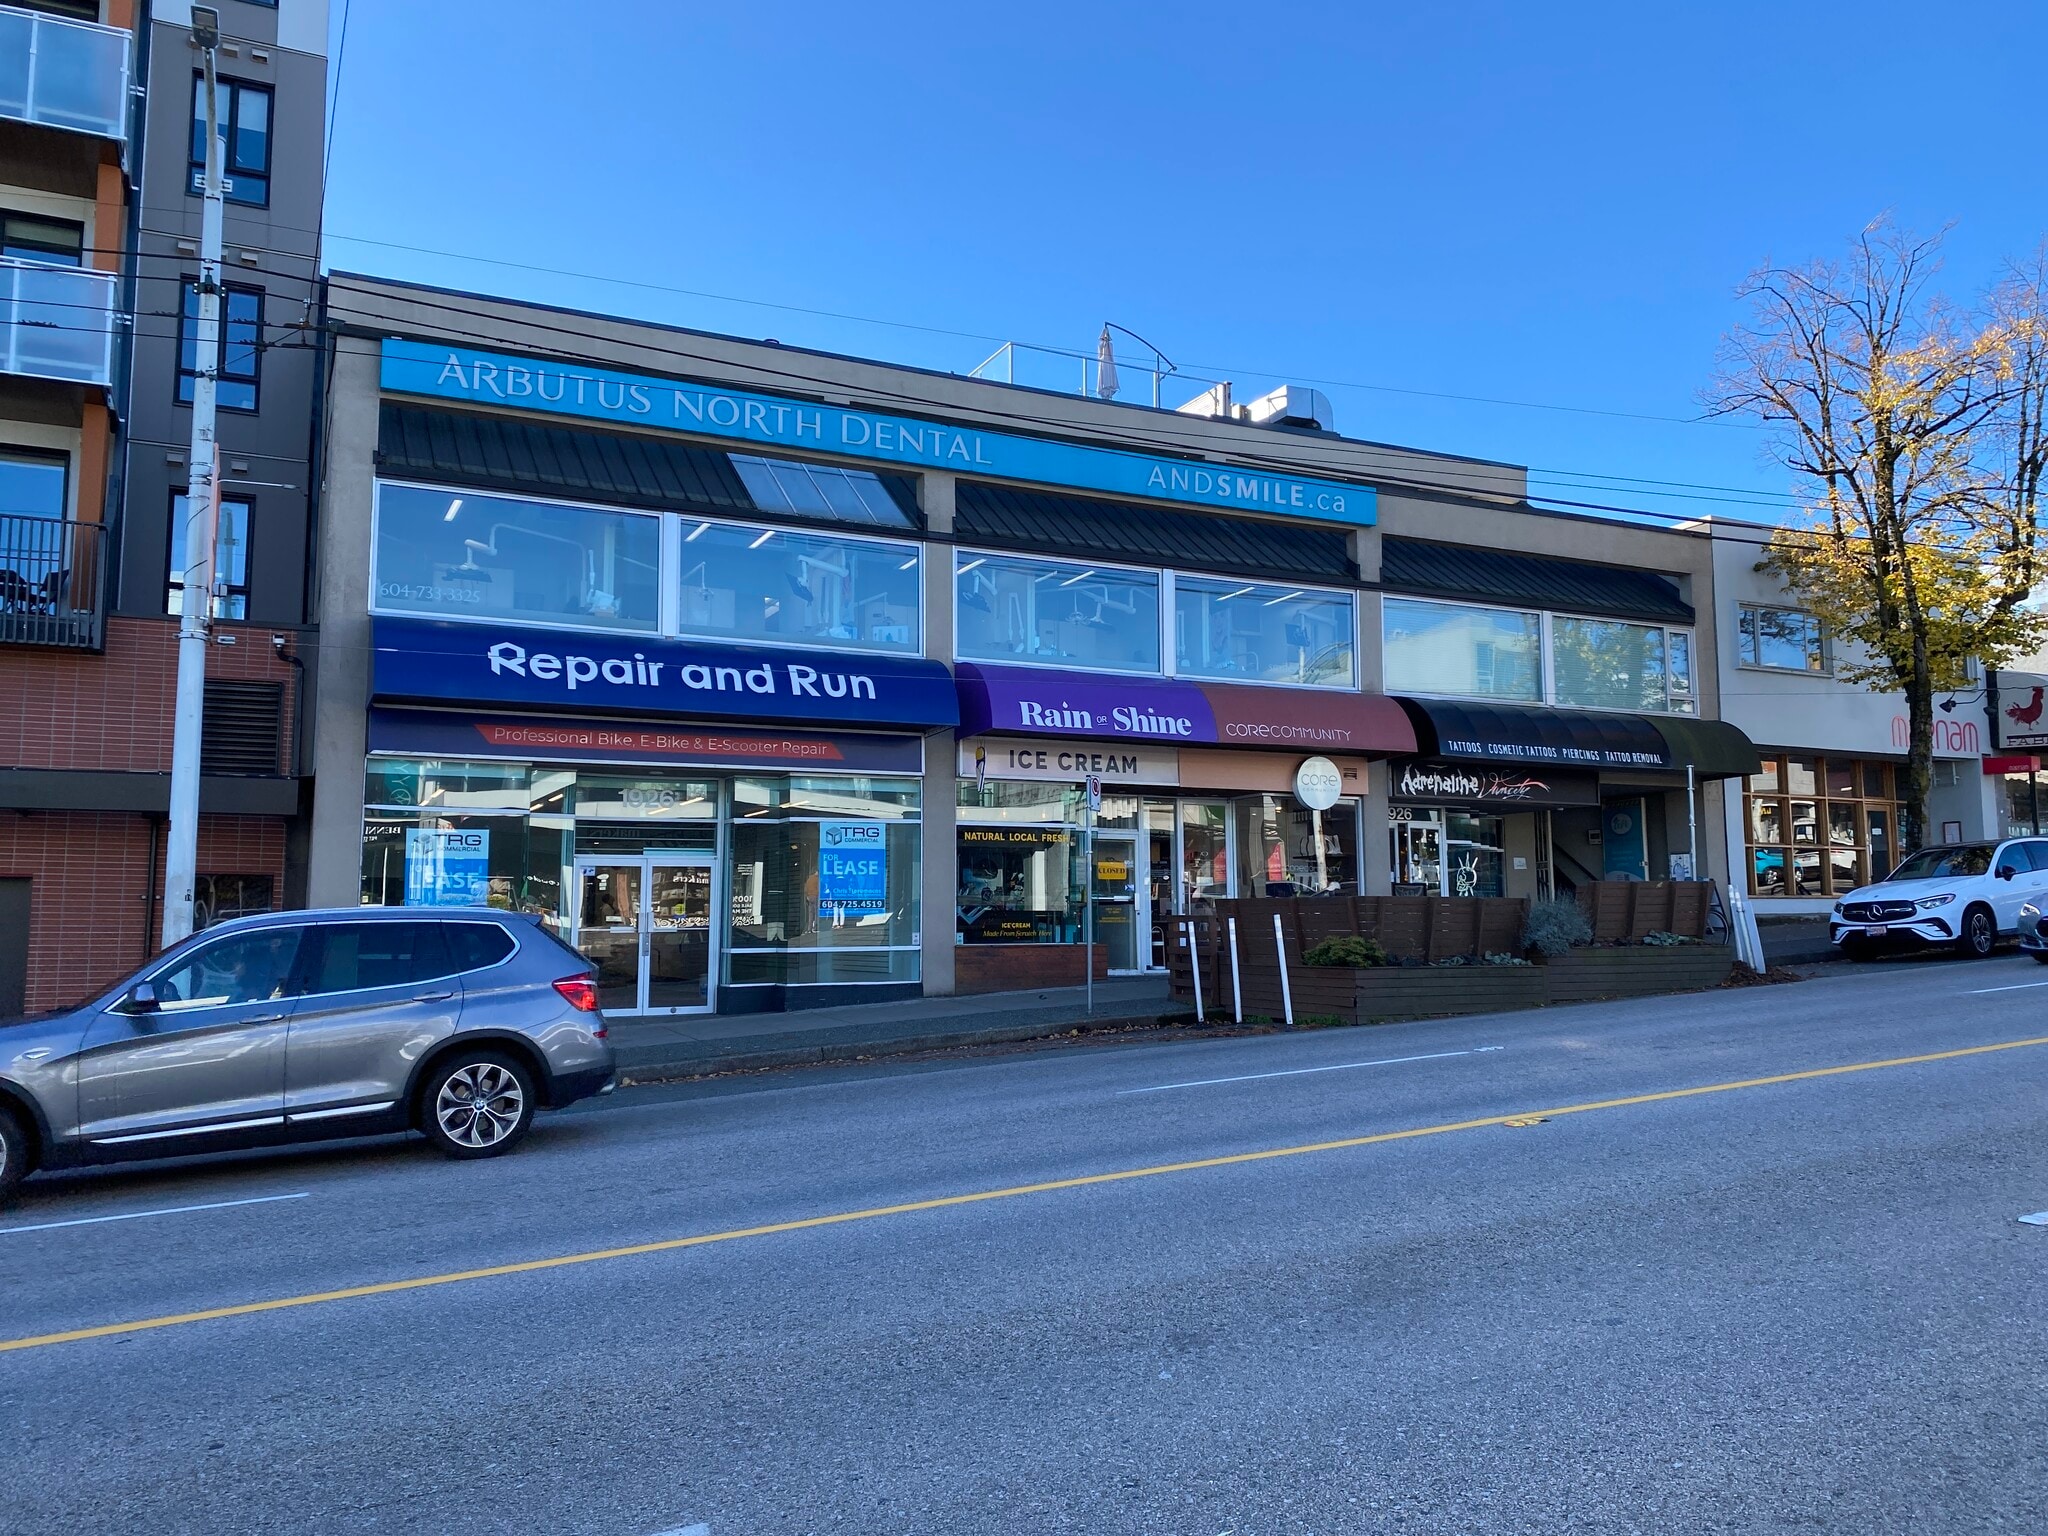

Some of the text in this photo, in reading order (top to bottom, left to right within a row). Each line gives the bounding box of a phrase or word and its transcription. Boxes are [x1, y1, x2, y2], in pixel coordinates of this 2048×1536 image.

[437, 353, 993, 465] ARBUTUS NORTH DENTAL
[1148, 465, 1345, 513] ANDSMILE.ca
[381, 583, 480, 603] 604-733-3325
[488, 641, 876, 700] Repair and Run
[1019, 700, 1192, 736] Rain OR Shine
[494, 726, 827, 757] Professional Bike, E-Bike & E-Scooter Repair
[1891, 716, 1979, 752] mnam
[2007, 736, 2048, 746] FAB
[1009, 749, 1138, 774] ICE CREAM
[1448, 741, 1663, 764] TATTOOS COSMETIC TATTOOS PIERCINGS TATTOO REMOVAL
[1401, 763, 1479, 796] Adrenaline
[618, 788, 674, 808] 1926
[432, 834, 482, 846] TRG
[840, 827, 880, 838] TRG
[964, 831, 1069, 843] NATURAL LOCAL FRESH
[823, 860, 879, 875] LEASE
[409, 871, 479, 889] LEASE
[821, 900, 883, 908] 604.725.4519
